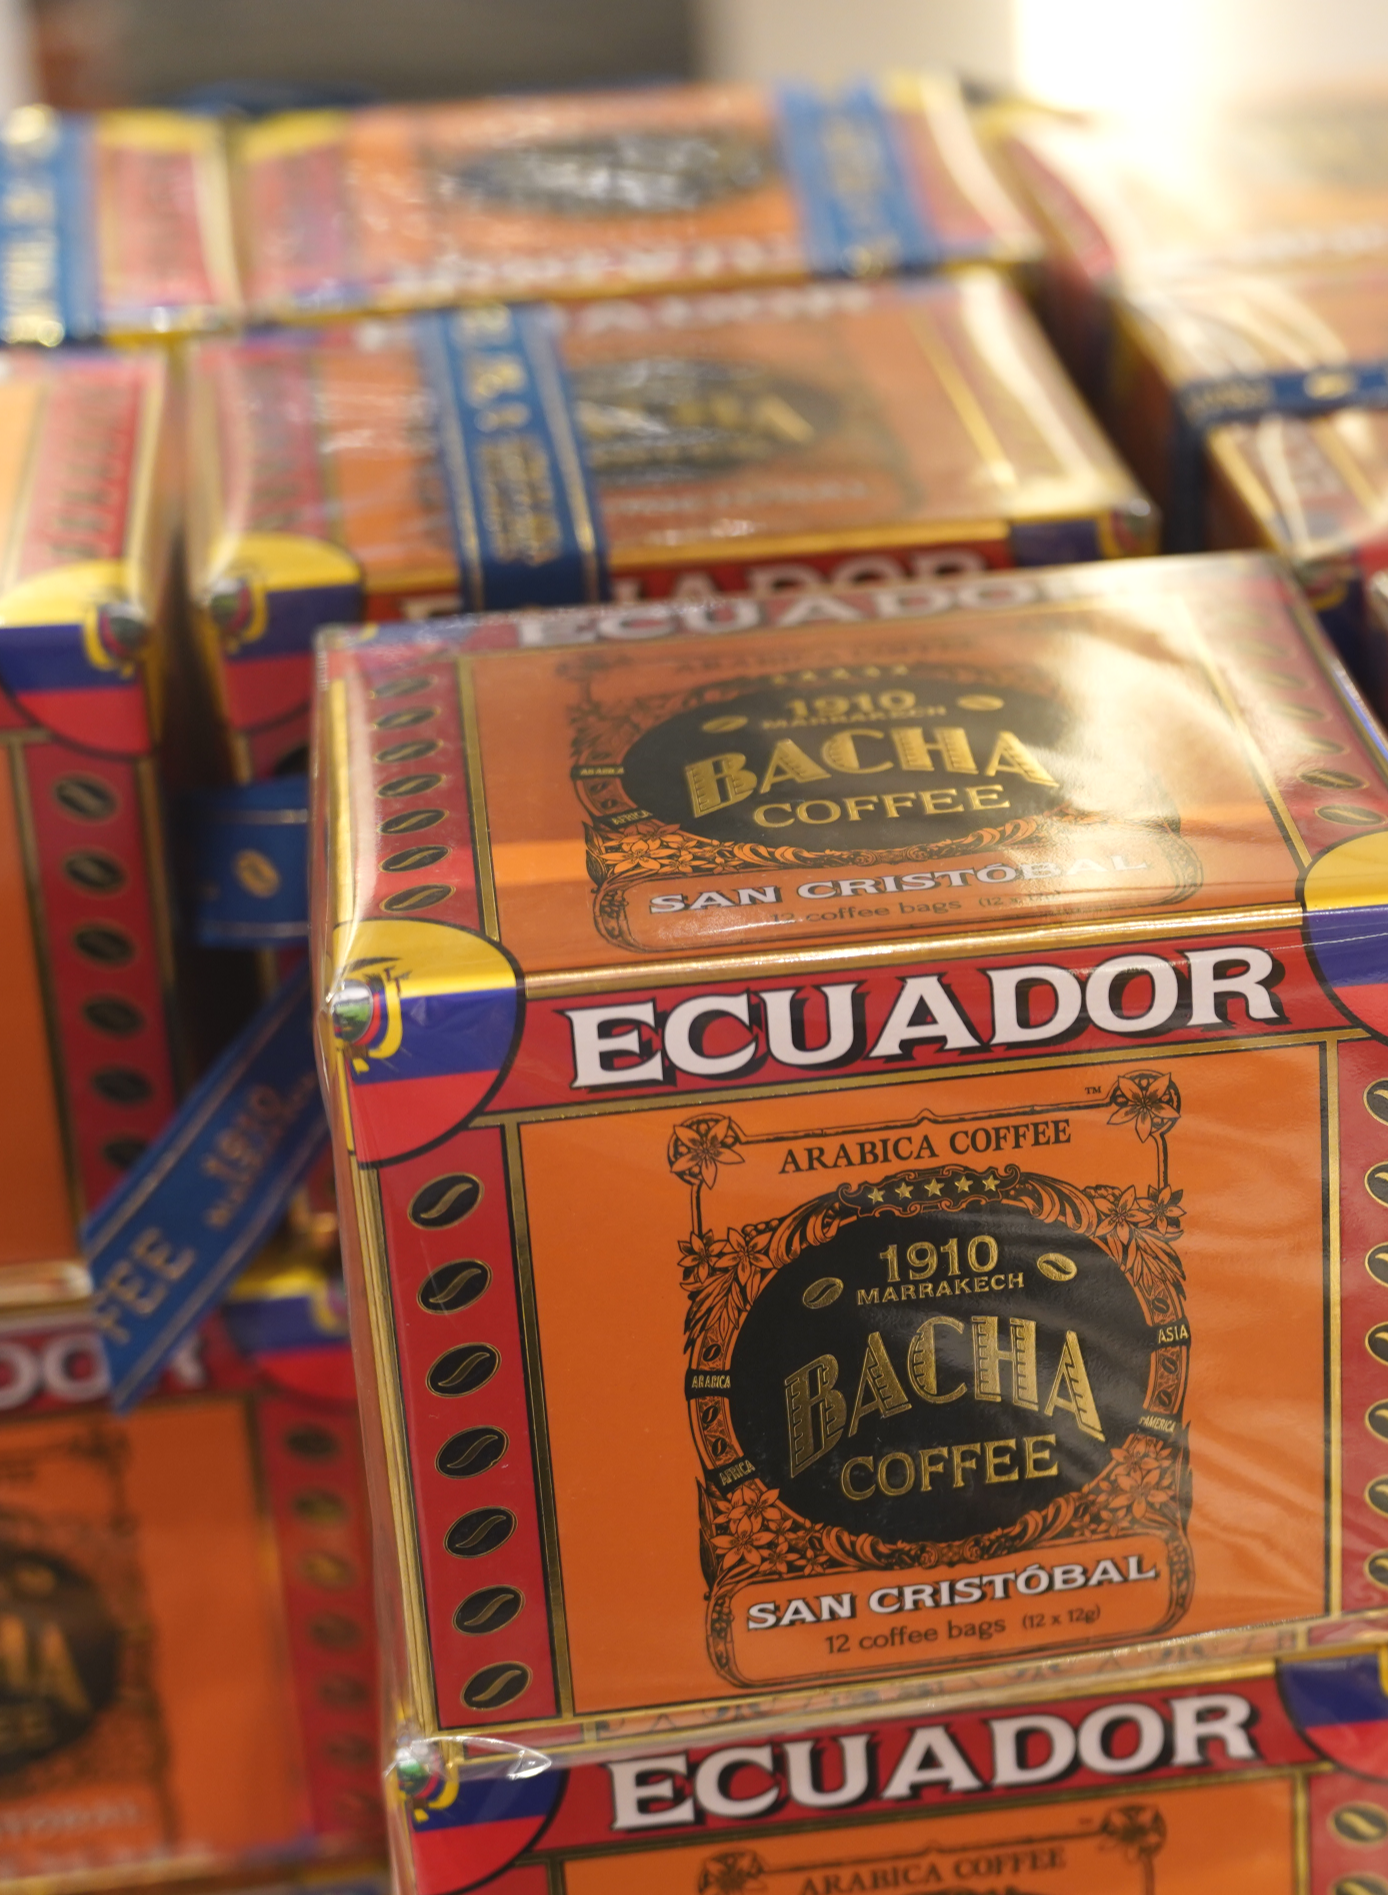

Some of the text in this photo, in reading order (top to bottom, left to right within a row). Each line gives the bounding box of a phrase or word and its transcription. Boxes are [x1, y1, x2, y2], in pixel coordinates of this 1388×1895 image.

[516, 572, 1090, 648] ECUADO
[785, 688, 918, 719] 1910
[683, 725, 1060, 819] BACHA
[752, 783, 1012, 829] COFFEE
[648, 855, 1149, 915] SAN CRISTÓBAL
[806, 905, 890, 923] coffee
[899, 893, 963, 915] bags
[562, 944, 1286, 1090] ECUADOR
[779, 1119, 1074, 1176] ARABICA COFFEE
[878, 1233, 999, 1285] 1910
[856, 1271, 1026, 1307] MARRAKECH
[1158, 1323, 1190, 1344] ASIA
[691, 1374, 732, 1389] ARABICA
[784, 1314, 1107, 1478] BACHA
[719, 1459, 757, 1487] AFRICA
[840, 1433, 1060, 1502] COFFEE
[747, 1554, 1160, 1632] SAN CRISTÓBAL
[823, 1602, 1102, 1656] 12 coffee bags (12 x 12g)
[606, 1692, 1264, 1832] ECUADOR
[800, 1845, 1068, 1895] ARABICA COFFEE
